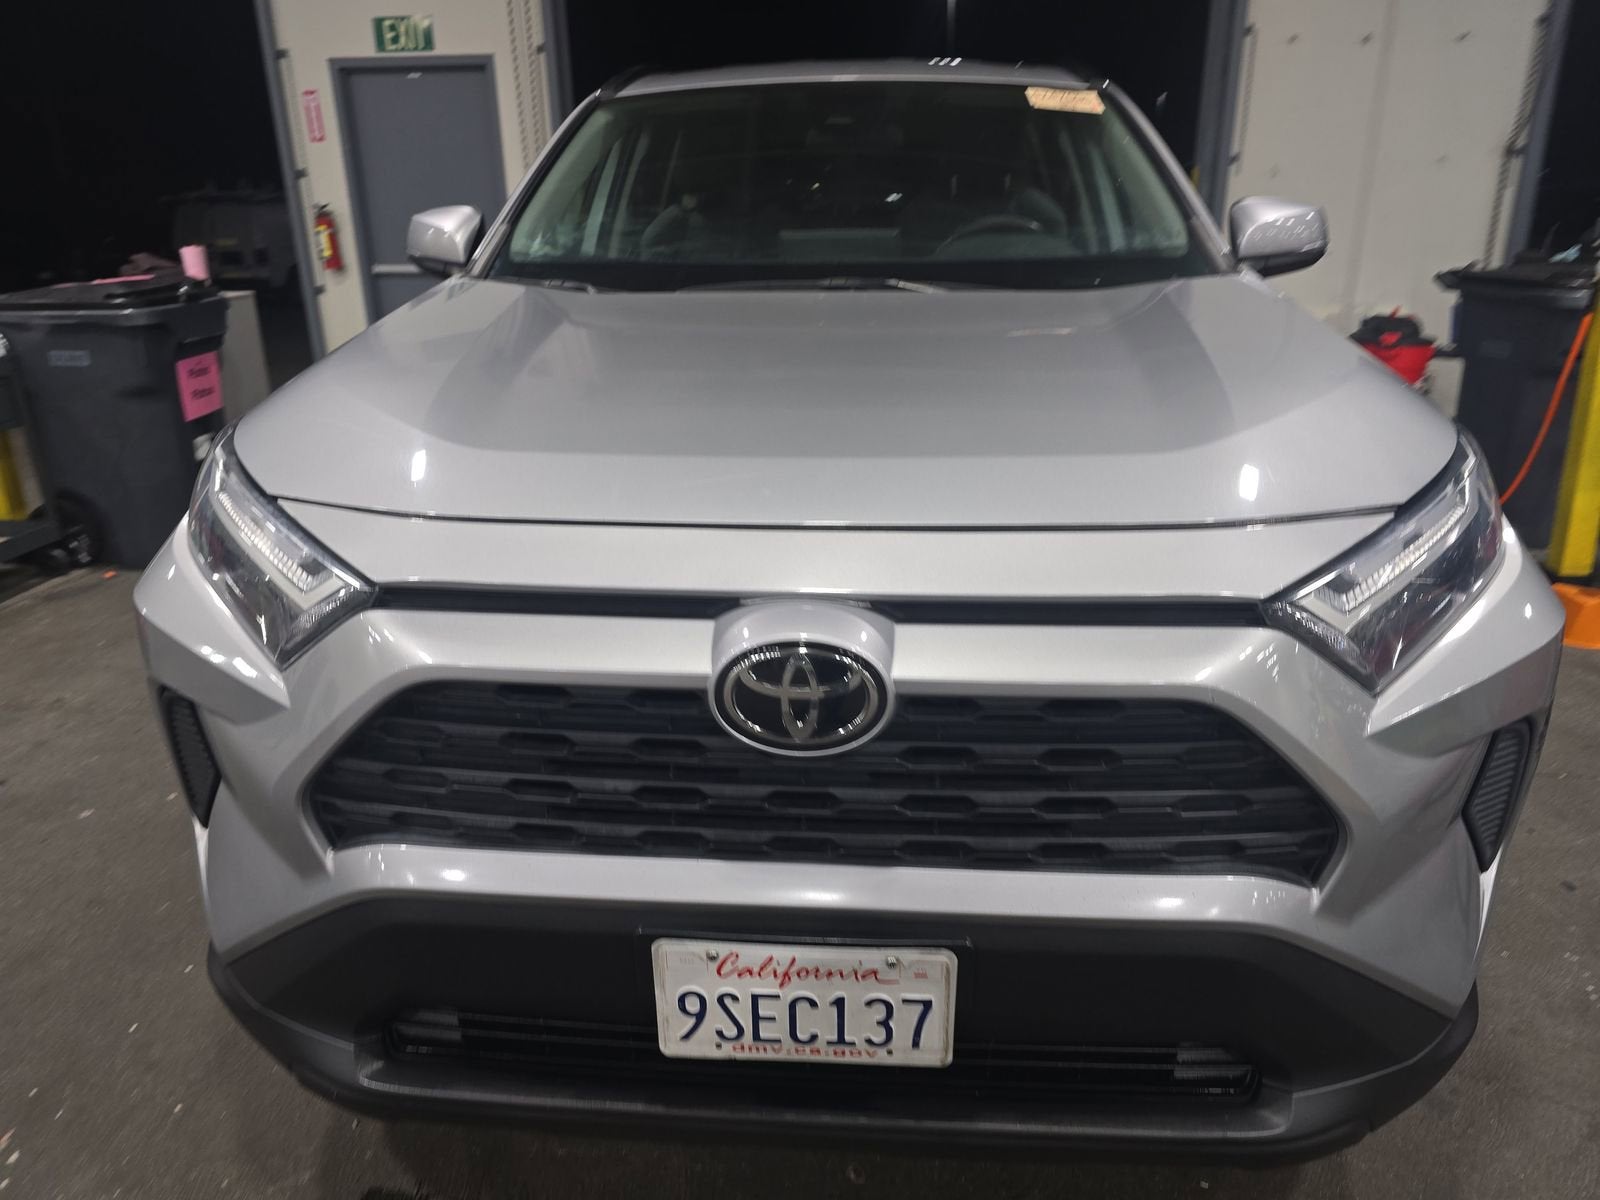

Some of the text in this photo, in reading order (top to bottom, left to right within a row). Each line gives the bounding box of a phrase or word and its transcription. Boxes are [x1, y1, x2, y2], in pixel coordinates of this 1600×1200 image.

[382, 18, 431, 50] EXIT
[716, 951, 898, 988] California
[677, 990, 933, 1050] 9SEC137
